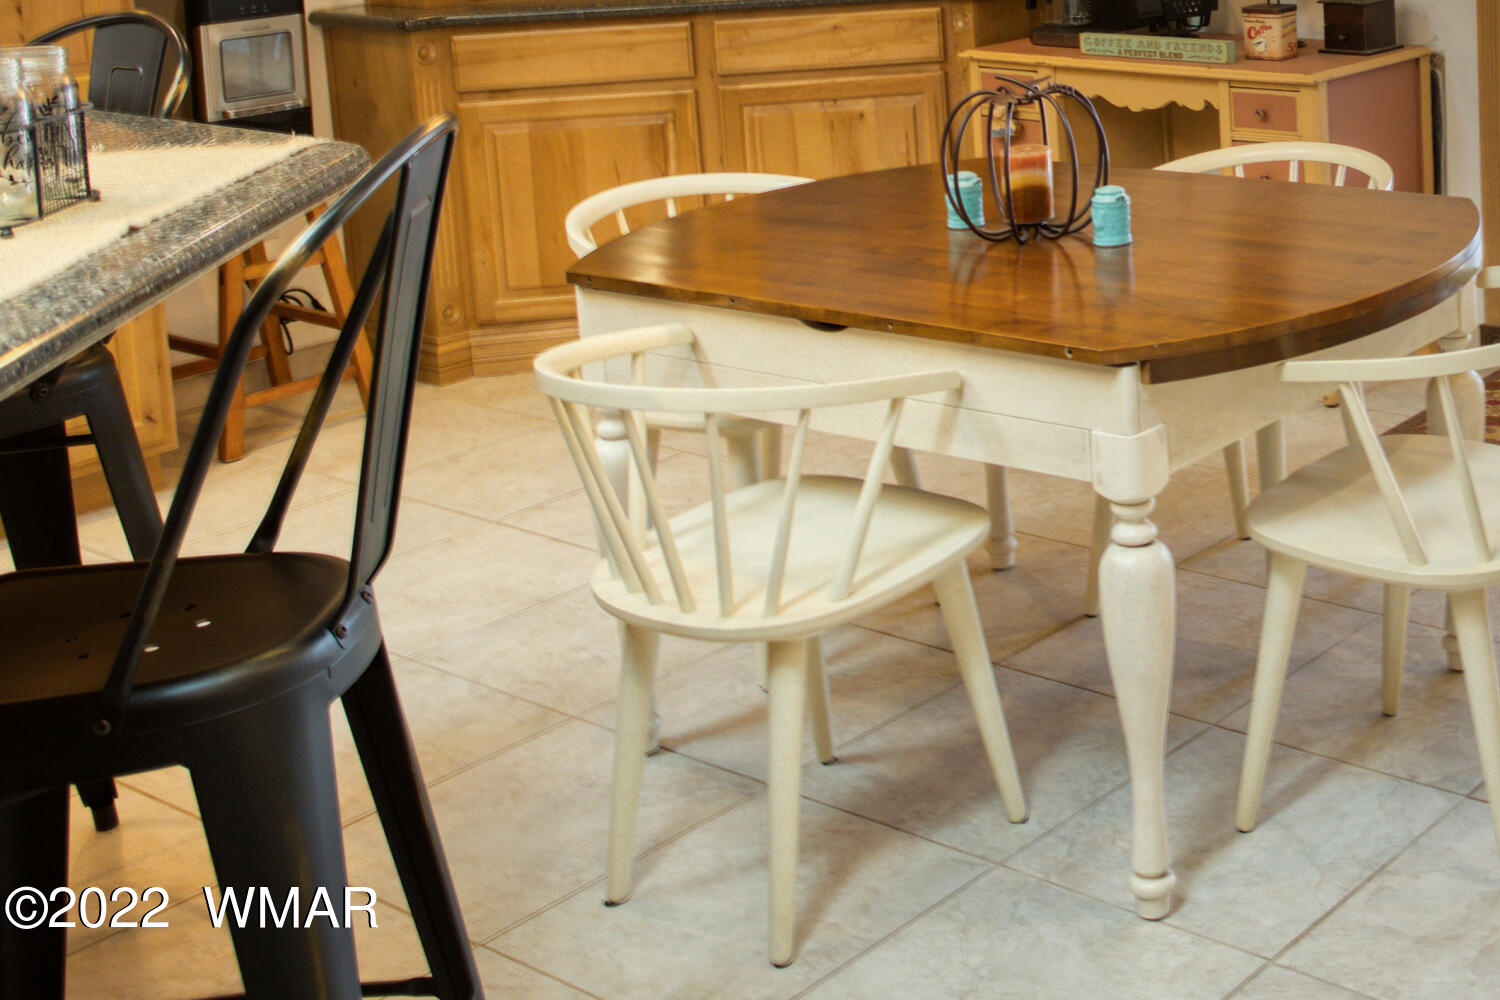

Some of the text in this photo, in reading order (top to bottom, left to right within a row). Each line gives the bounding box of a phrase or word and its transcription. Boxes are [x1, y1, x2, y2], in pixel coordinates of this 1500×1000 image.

[1083, 35, 1223, 55] COFFEE AND FRIENDS
[1124, 49, 1158, 58] PERFECT
[1159, 50, 1184, 60] BLEND
